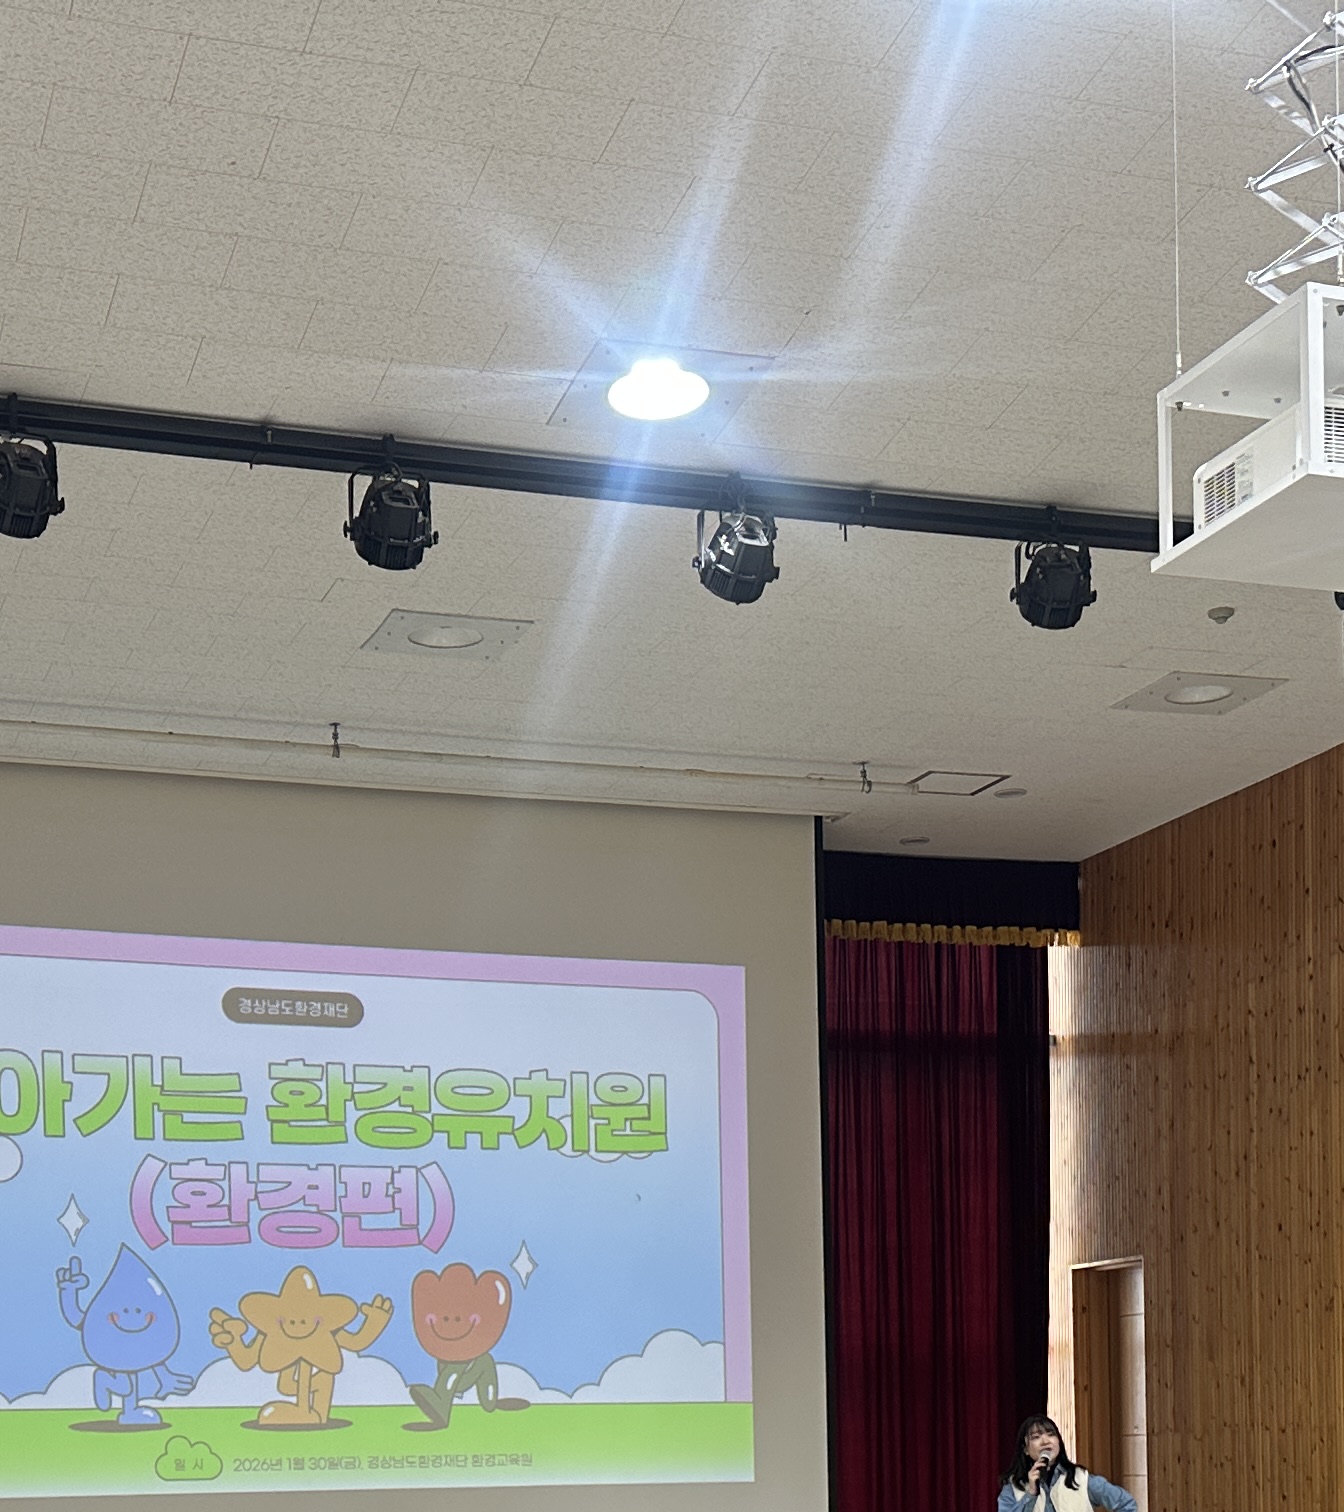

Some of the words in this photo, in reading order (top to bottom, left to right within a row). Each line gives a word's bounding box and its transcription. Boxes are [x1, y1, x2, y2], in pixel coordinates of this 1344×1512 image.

[238, 997, 349, 1019] 경상남도환경재단
[265, 1056, 669, 1155] 환경유치원
[131, 1154, 455, 1255] (환경편)
[232, 1457, 283, 1472] 2026년
[286, 1456, 305, 1471] 1월
[366, 1453, 469, 1470] 경상남도환경재단
[470, 1452, 533, 1468] 환경교육원
